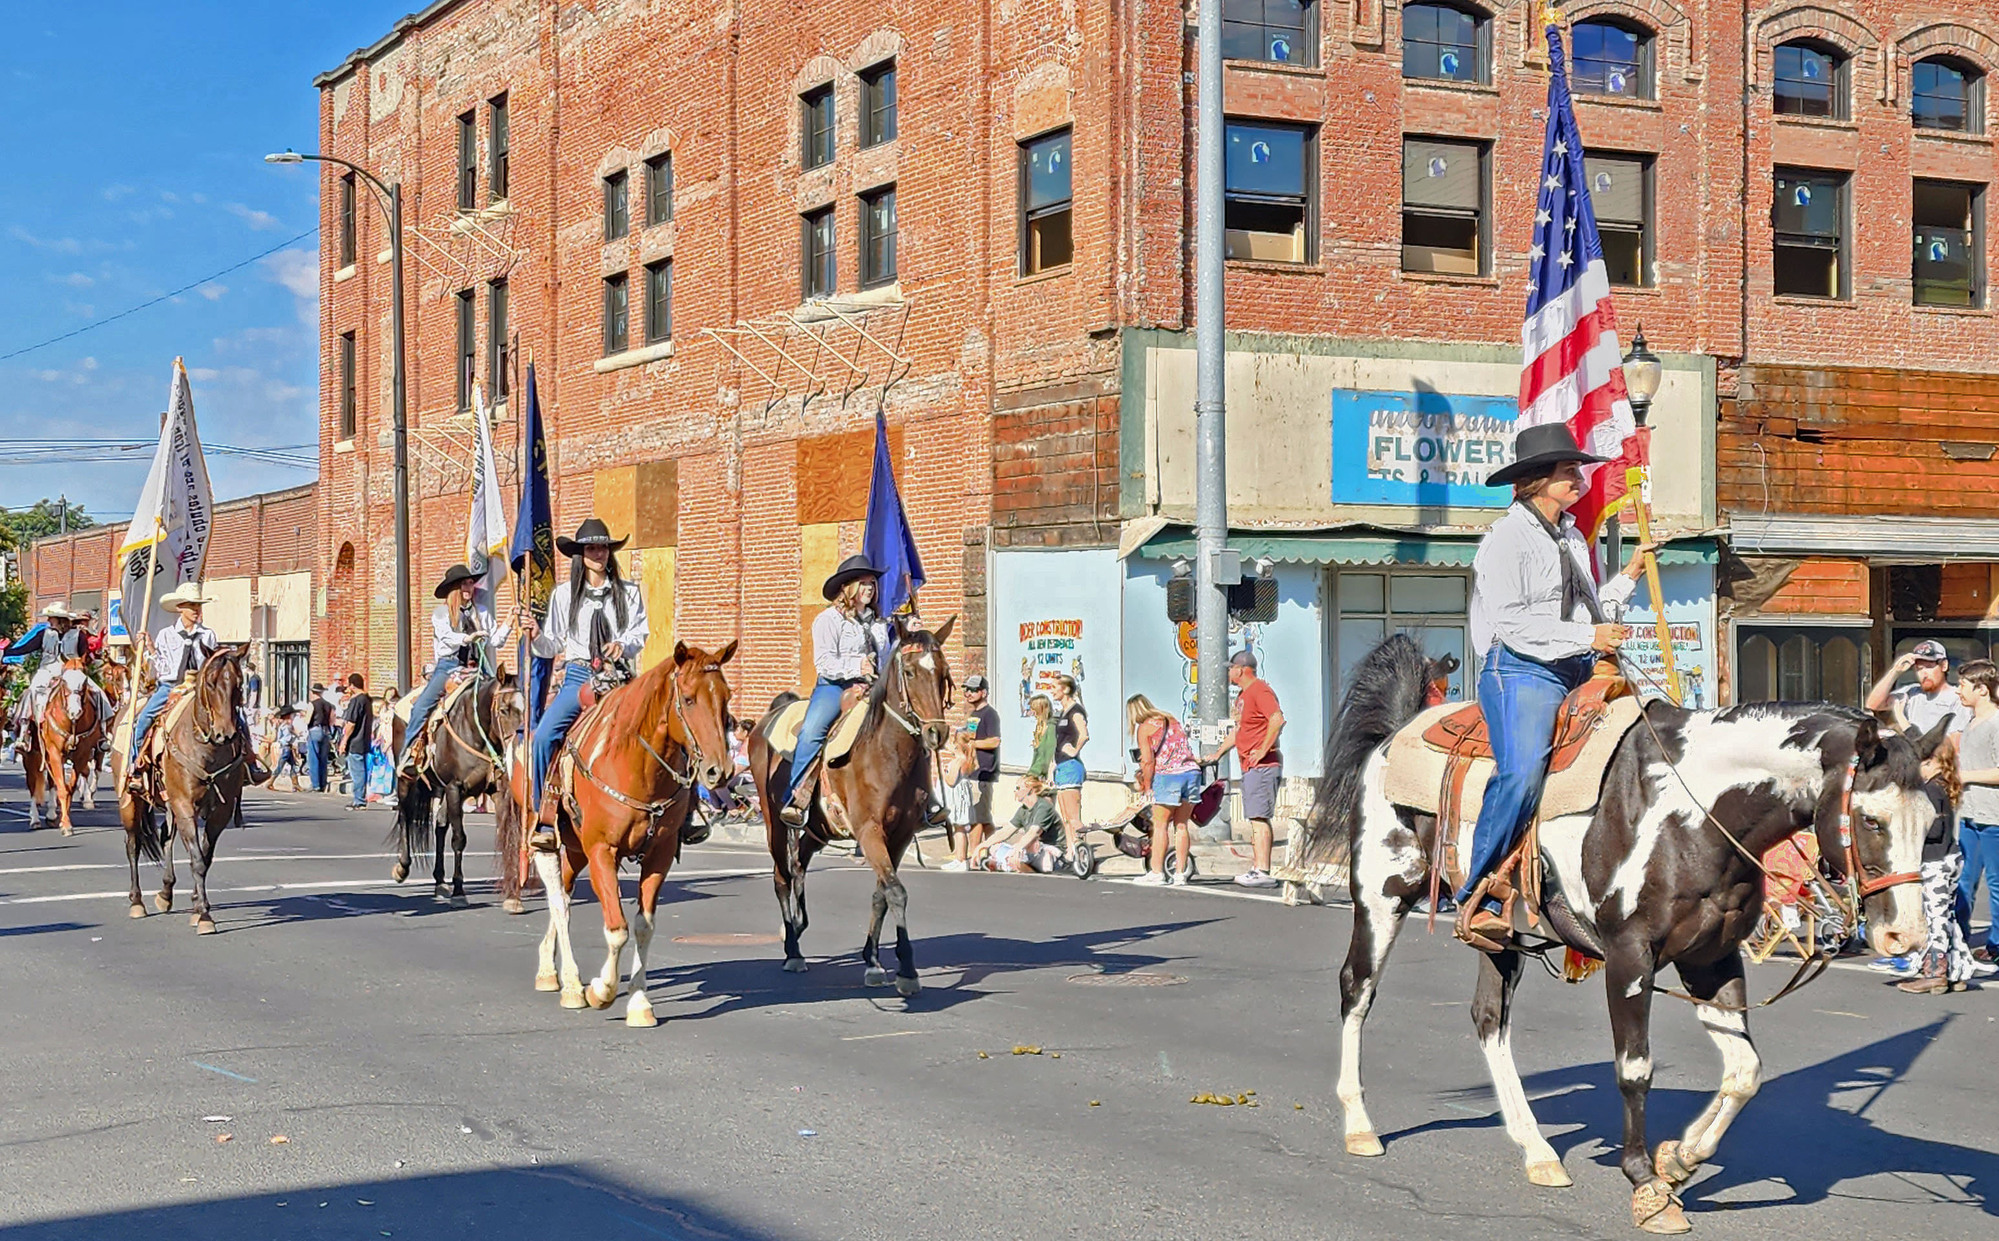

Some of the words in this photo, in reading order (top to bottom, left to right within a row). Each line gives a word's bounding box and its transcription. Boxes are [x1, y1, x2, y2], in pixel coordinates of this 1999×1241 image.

[1636, 626, 1698, 640] CONSUCTION
[1037, 653, 1044, 664] 12
[1045, 653, 1063, 665] UNITS
